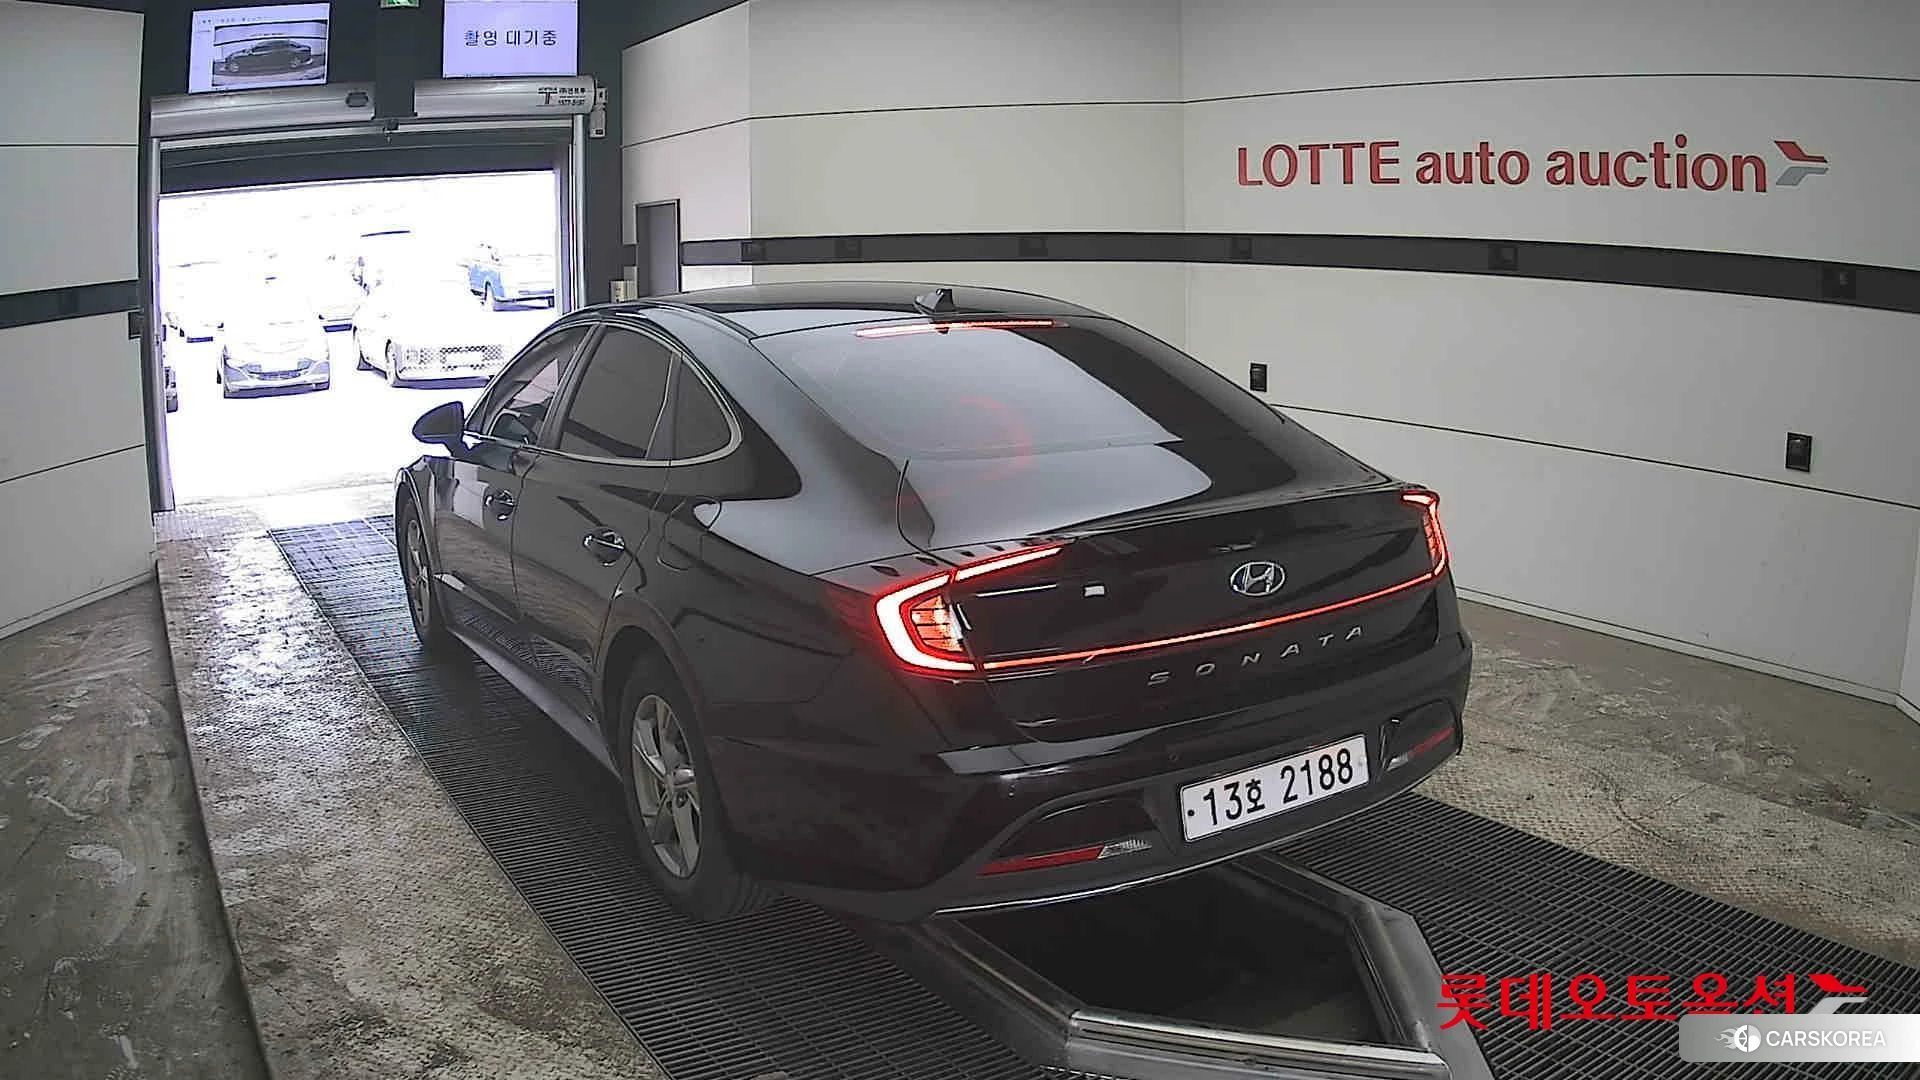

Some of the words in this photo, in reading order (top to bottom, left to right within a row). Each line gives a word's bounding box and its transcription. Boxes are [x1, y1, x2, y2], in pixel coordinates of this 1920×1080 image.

[506, 30, 556, 46] 대기중
[1237, 141, 1400, 187] LOTTE
[1415, 141, 1530, 185] auto
[1546, 134, 1767, 192] auction
[1147, 626, 1363, 686] SONATA
[1203, 778, 1265, 826] 13호
[1280, 748, 1353, 804] 2188
